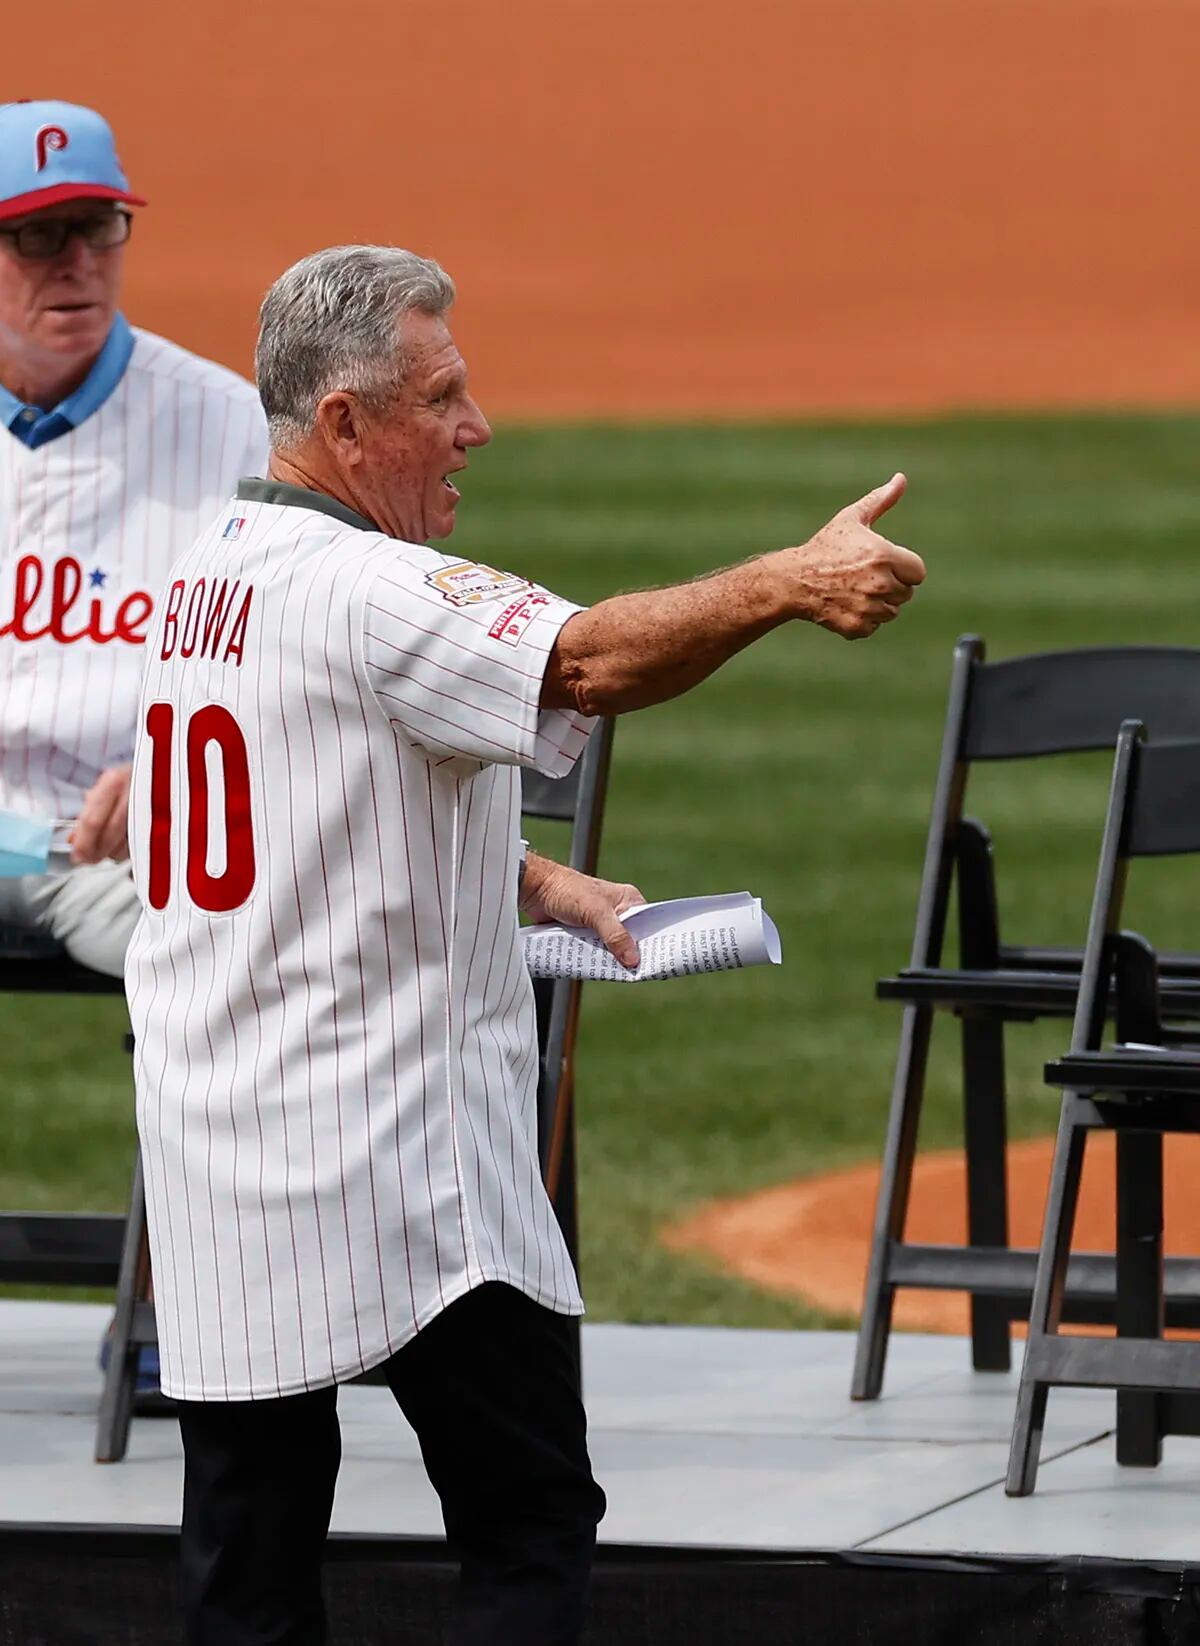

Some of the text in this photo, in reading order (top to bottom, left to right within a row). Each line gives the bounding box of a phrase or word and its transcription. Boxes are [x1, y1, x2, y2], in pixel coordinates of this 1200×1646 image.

[35, 123, 69, 173] P
[160, 576, 254, 668] BOWA
[146, 702, 256, 912] 10
[700, 930, 708, 949] FIRST
[729, 926, 738, 946] Good
[681, 950, 688, 958] of
[690, 931, 698, 963] welcome
[590, 957, 596, 967] on
[589, 968, 596, 977] to
